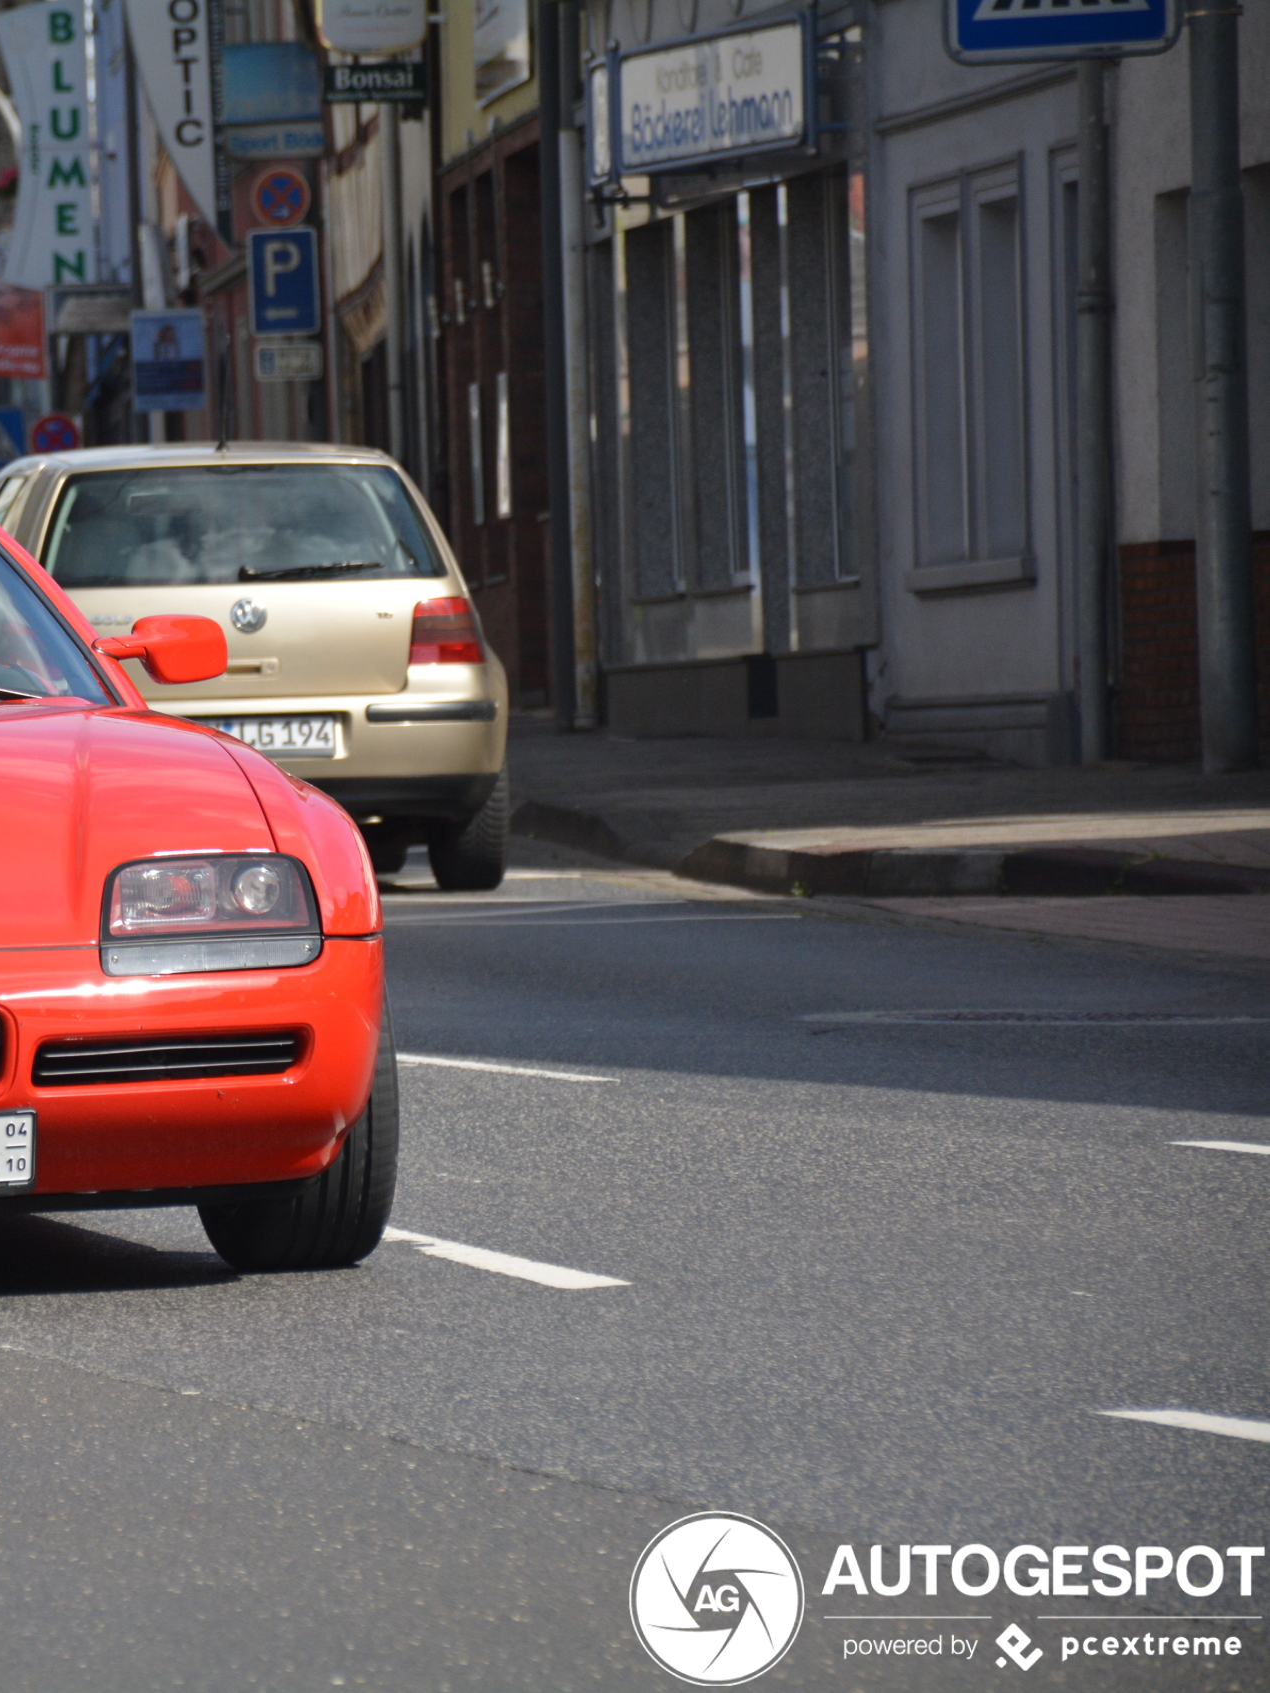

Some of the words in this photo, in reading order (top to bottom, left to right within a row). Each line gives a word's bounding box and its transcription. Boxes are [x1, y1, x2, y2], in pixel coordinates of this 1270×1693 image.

[168, 0, 204, 147] OPTIC
[334, 65, 414, 90] Bonsai
[48, 11, 86, 284] BLUMEN
[264, 241, 301, 297] P
[5, 1122, 27, 1138] 04
[6, 1157, 26, 1173] 10
